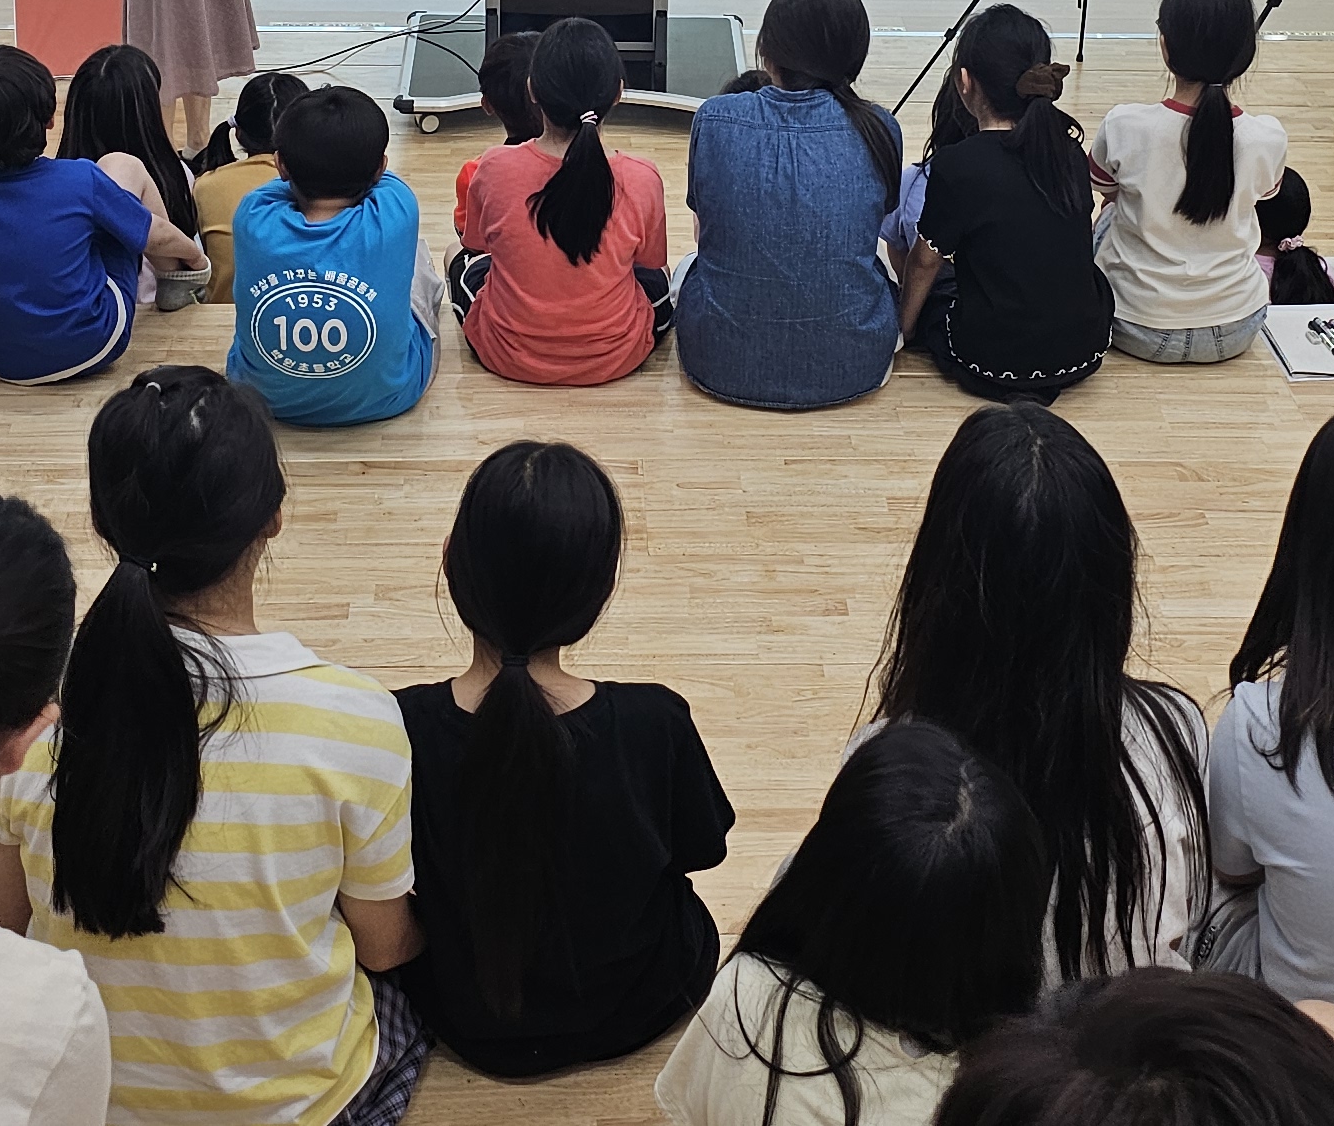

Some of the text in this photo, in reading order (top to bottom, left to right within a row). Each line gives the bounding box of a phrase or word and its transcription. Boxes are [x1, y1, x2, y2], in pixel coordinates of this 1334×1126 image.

[282, 269, 318, 281] 가꾸는
[285, 293, 339, 312] 1953
[273, 315, 348, 353] 100
